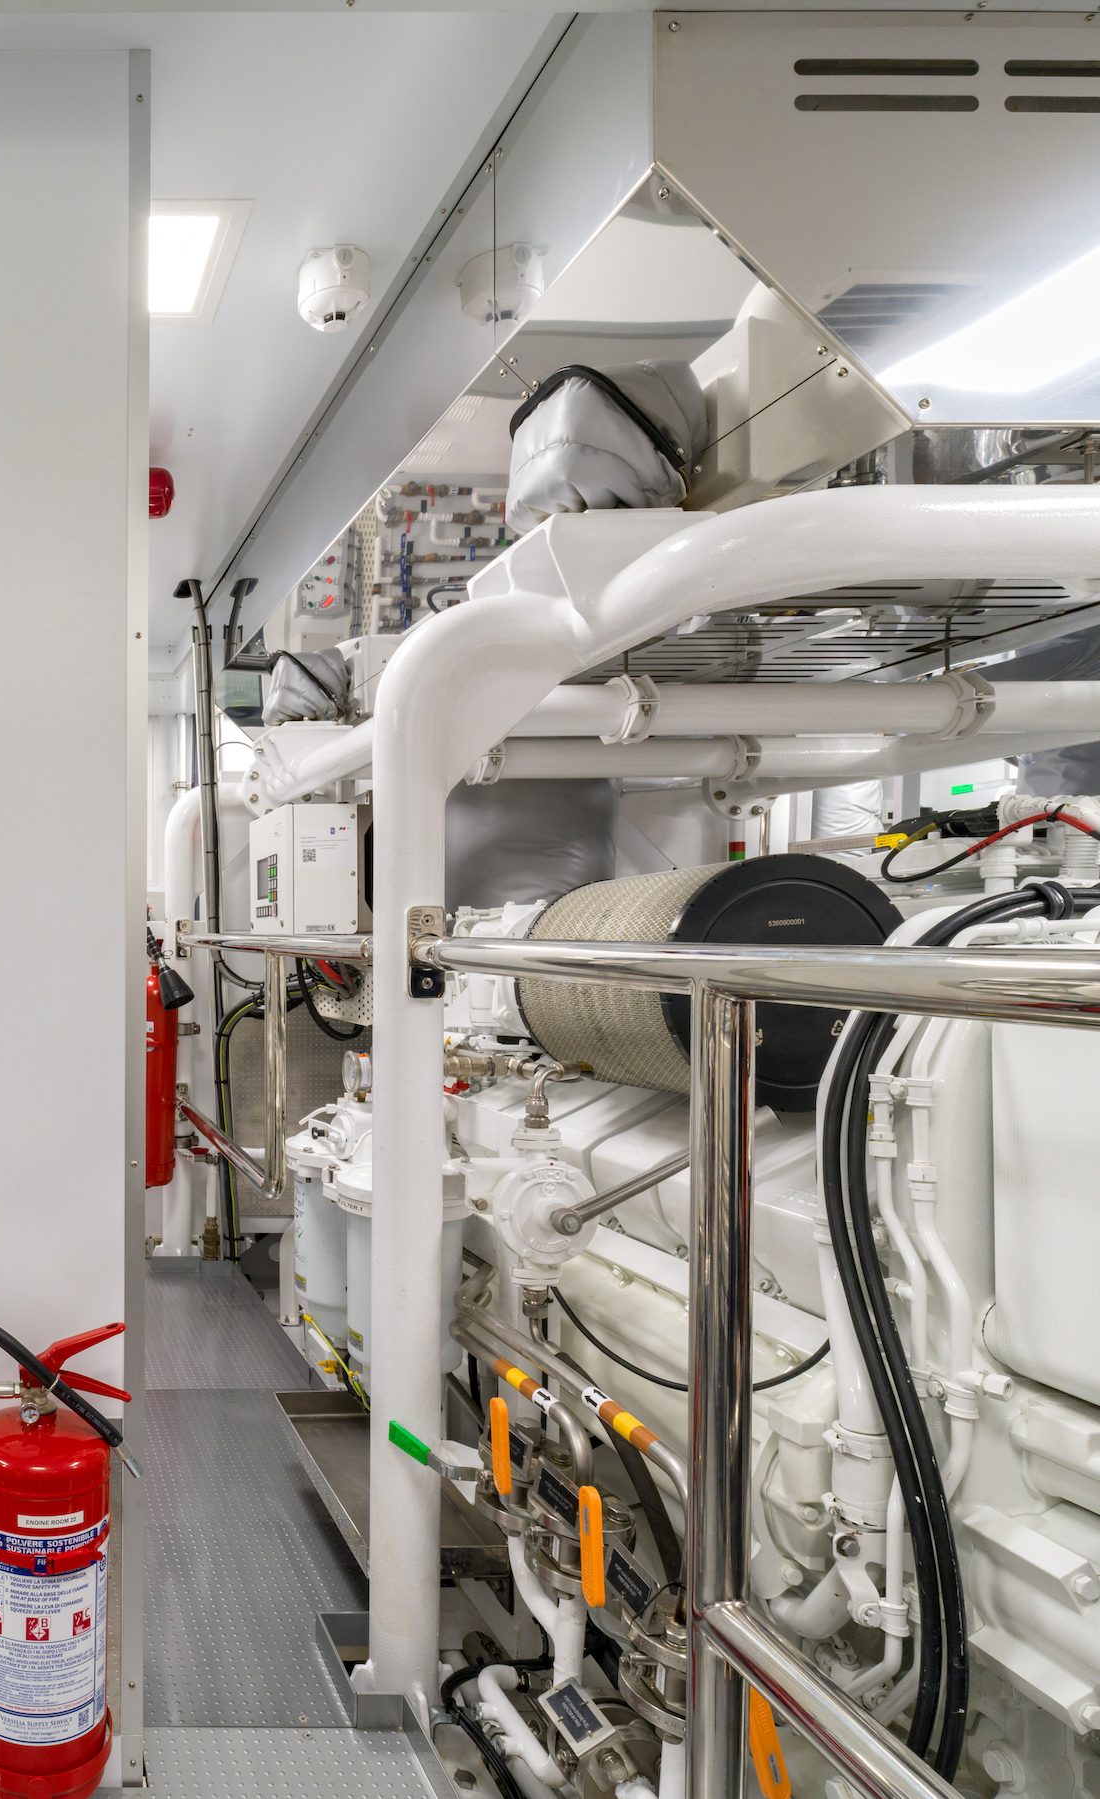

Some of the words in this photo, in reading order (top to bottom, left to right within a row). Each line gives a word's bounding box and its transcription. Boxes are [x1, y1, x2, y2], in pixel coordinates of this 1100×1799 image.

[6, 1537, 44, 1548] POLVERE
[47, 1530, 94, 1548] SOSTENIBILE
[63, 1572, 86, 1582] SICUREZZA
[61, 1598, 83, 1608] COMANDO
[85, 1608, 90, 1618] C
[41, 1618, 48, 1627] B
[5, 1645, 26, 1653] DISTANZA
[0, 1659, 20, 1668] DISTANCE
[77, 1654, 88, 1663] AFTER
[66, 1652, 82, 1662] VOLTAGE
[0, 1715, 25, 1726] VERSILIA
[50, 1716, 72, 1726] SERVICE
